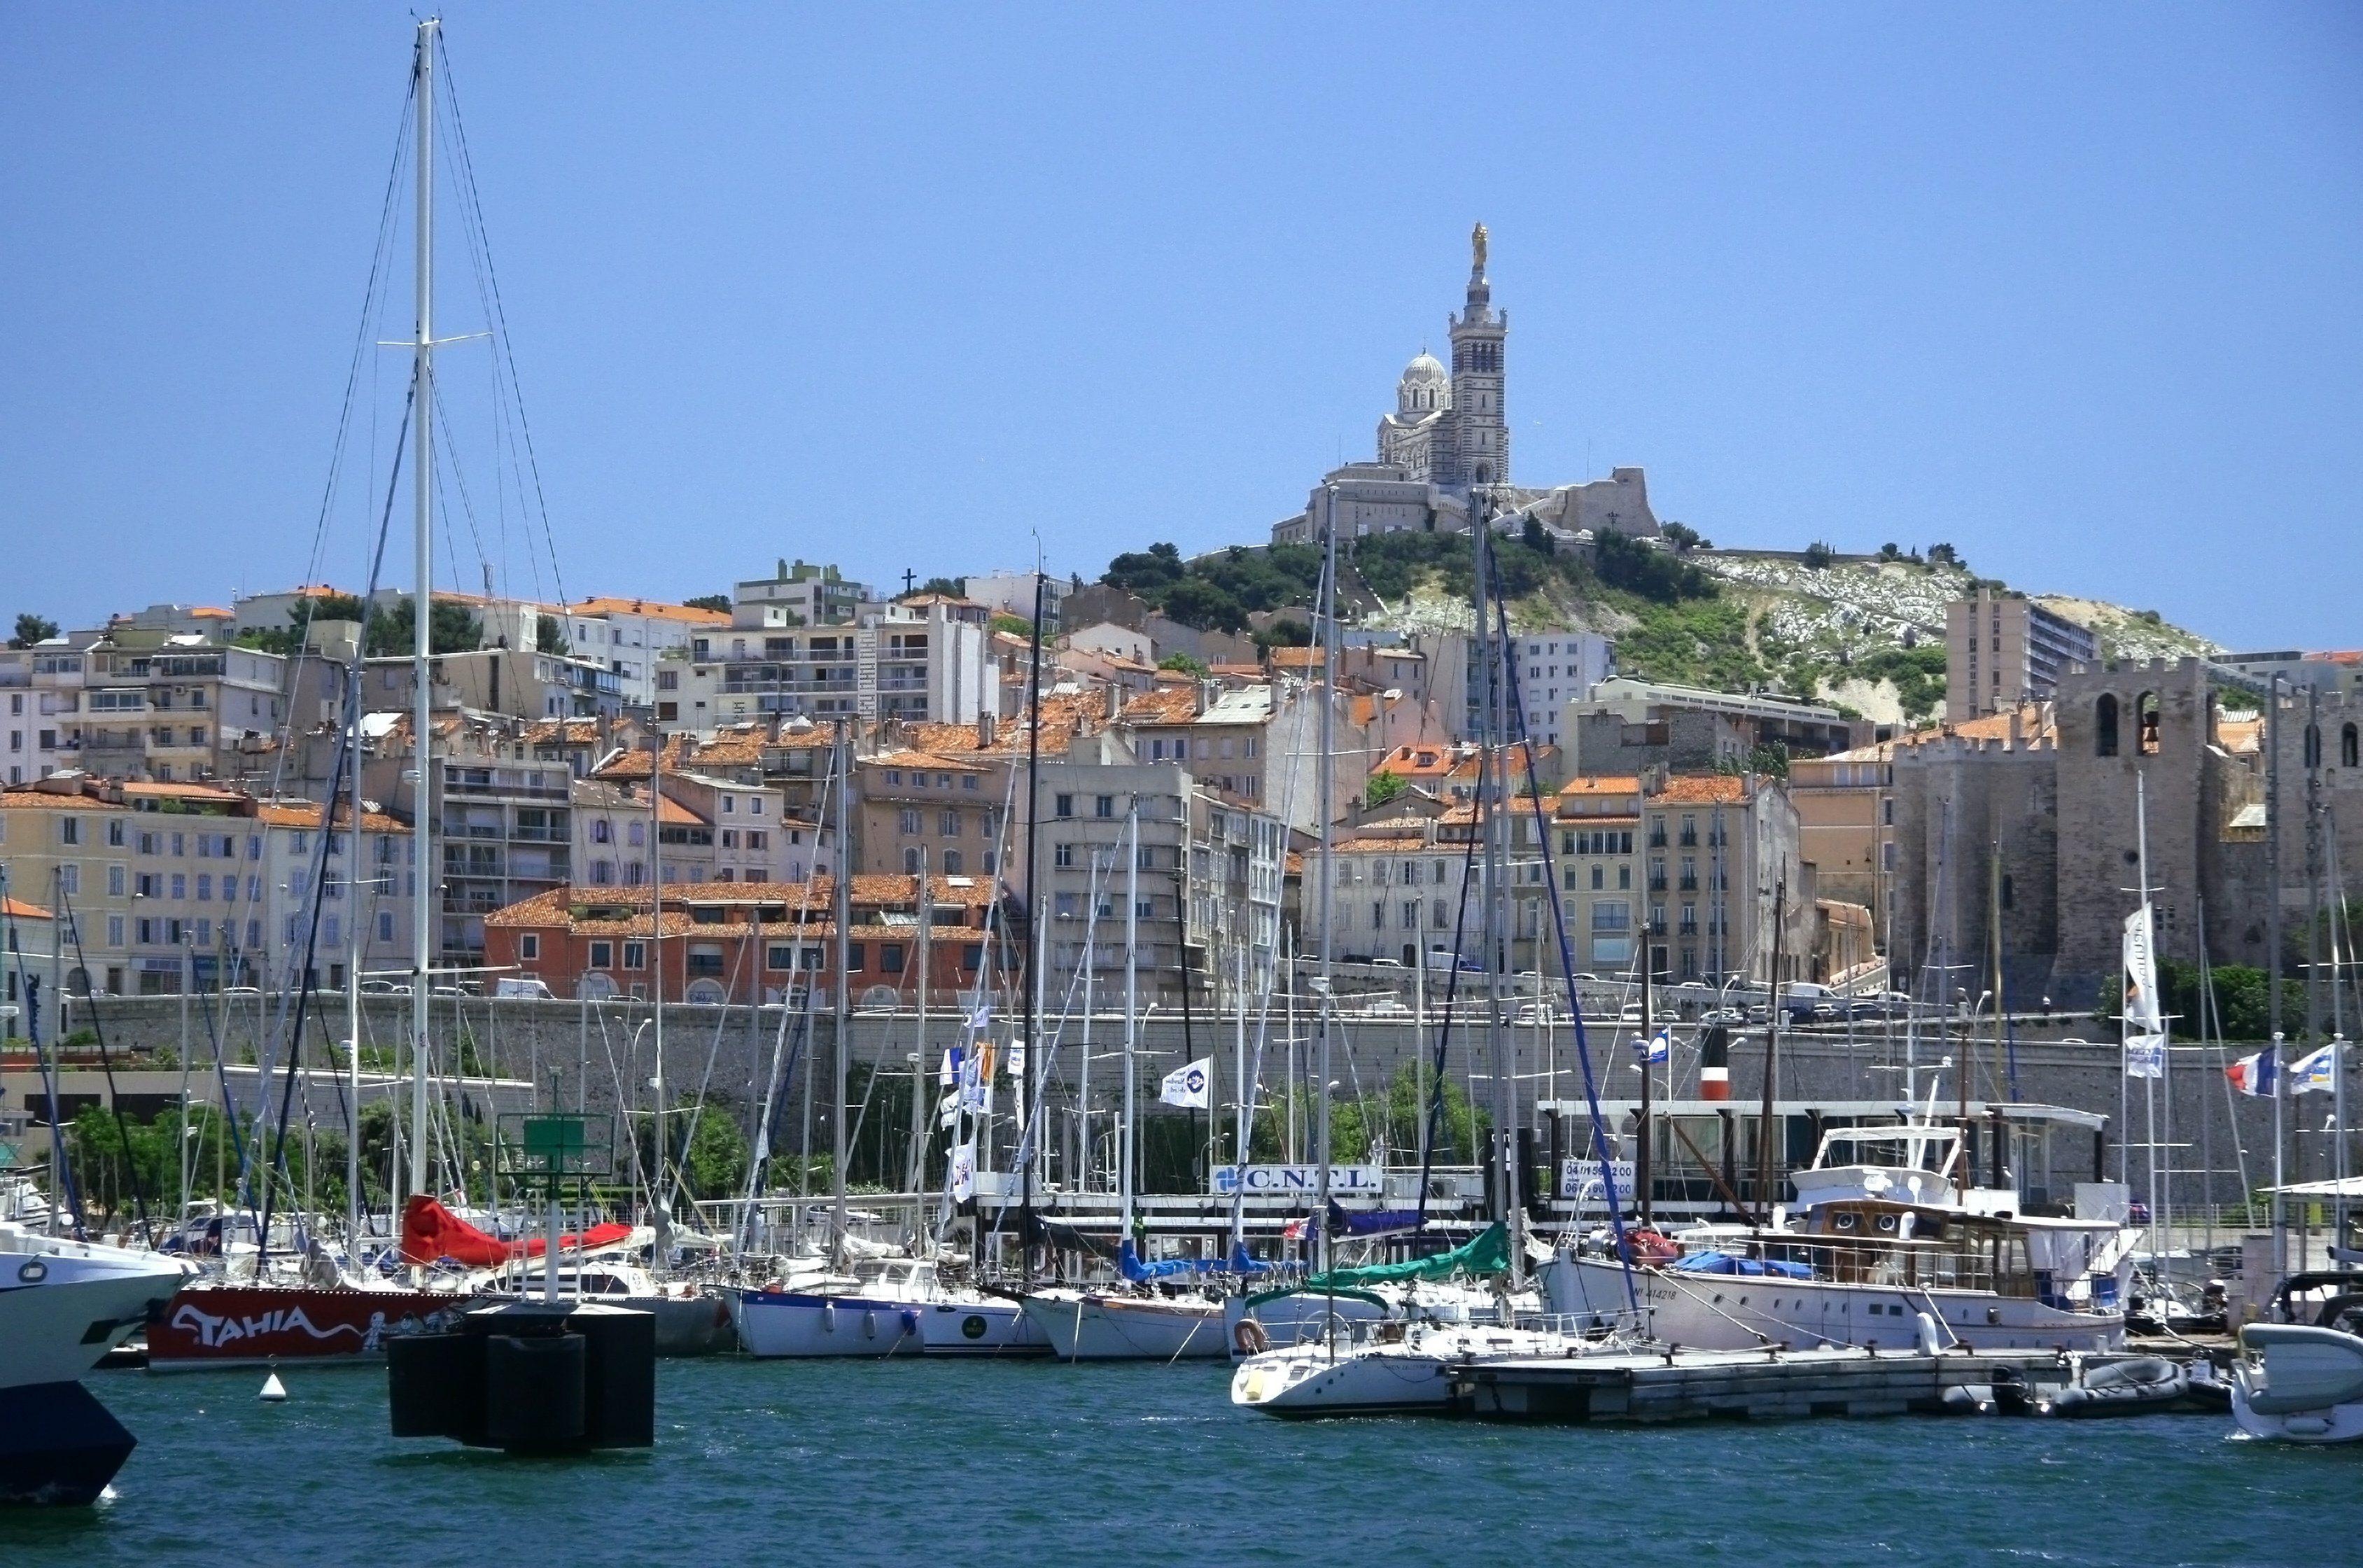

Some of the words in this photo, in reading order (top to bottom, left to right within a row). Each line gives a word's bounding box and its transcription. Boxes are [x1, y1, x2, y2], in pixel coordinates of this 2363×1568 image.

[1566, 1166, 1578, 1175] 04
[1620, 1167, 1632, 1176] 00
[1566, 1183, 1577, 1193] 06
[1619, 1184, 1631, 1194] 00
[1646, 1289, 1676, 1300] 414218
[171, 1304, 322, 1348] TAHIA
